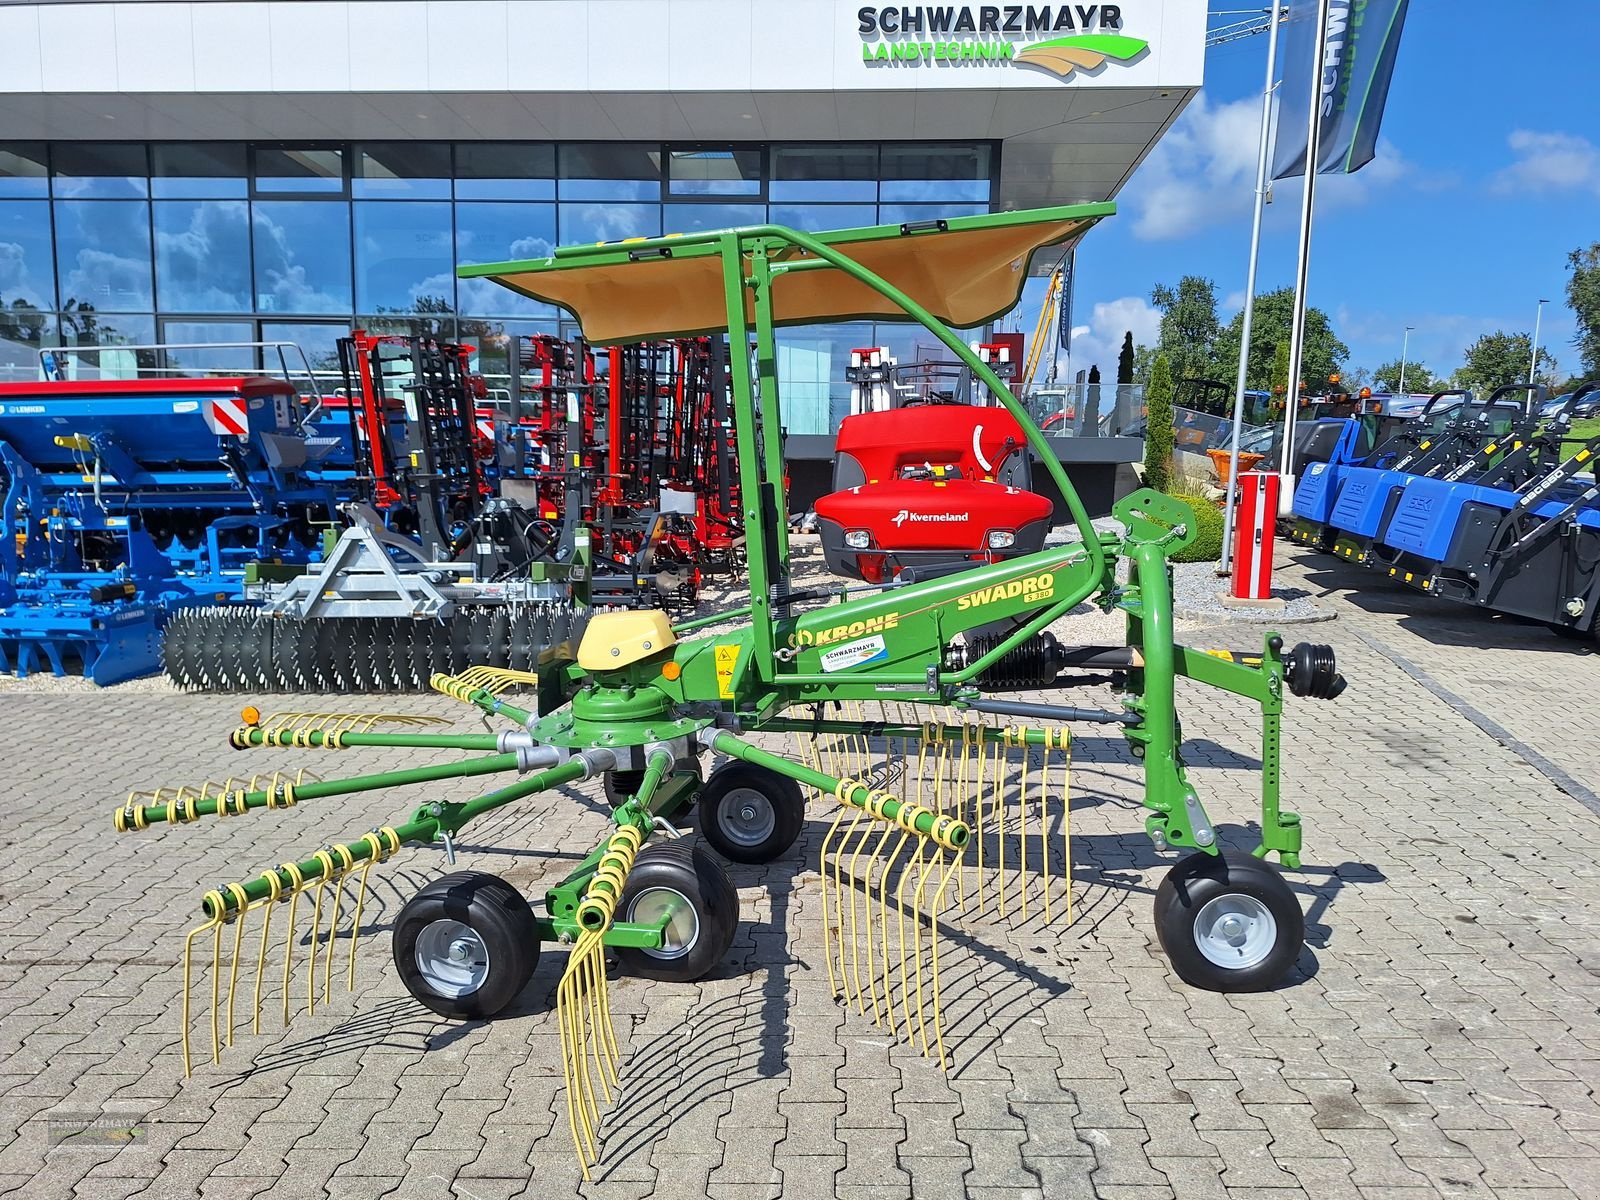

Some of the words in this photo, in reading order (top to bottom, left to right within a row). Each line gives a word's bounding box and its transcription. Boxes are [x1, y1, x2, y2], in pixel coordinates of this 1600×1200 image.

[857, 5, 1121, 33] SCHWARZMAYR
[862, 41, 1014, 61] LANDTECHNIK
[1321, 0, 1350, 118] SCHW
[16, 405, 46, 414] LEMKEN
[909, 512, 969, 521] Kverneland
[957, 573, 1054, 611] SWADRO
[815, 612, 899, 646] KRONE
[825, 642, 875, 660] SCHWARZMAYR
